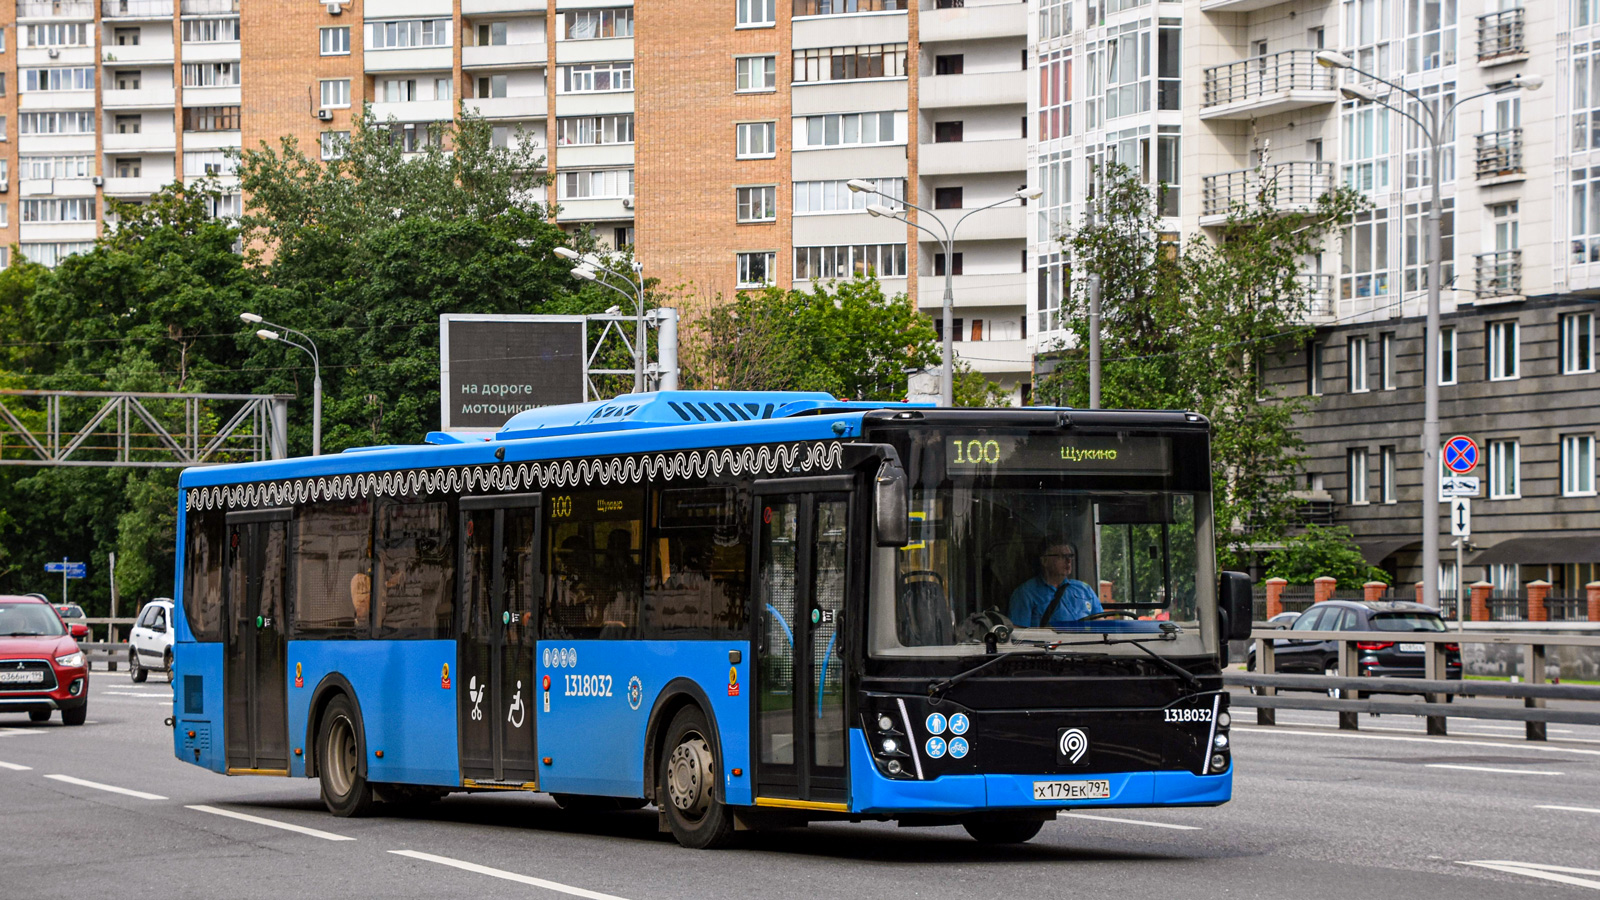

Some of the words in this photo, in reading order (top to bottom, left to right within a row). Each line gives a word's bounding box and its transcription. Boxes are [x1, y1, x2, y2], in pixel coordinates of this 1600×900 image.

[461, 384, 478, 394] на
[482, 384, 532, 396] дороге
[953, 440, 1000, 464] 100
[1060, 446, 1117, 462] Щукино
[552, 495, 572, 518] 100
[564, 674, 613, 697] 1318032
[1164, 708, 1212, 722] 1318032
[1088, 782, 1106, 793] 797
